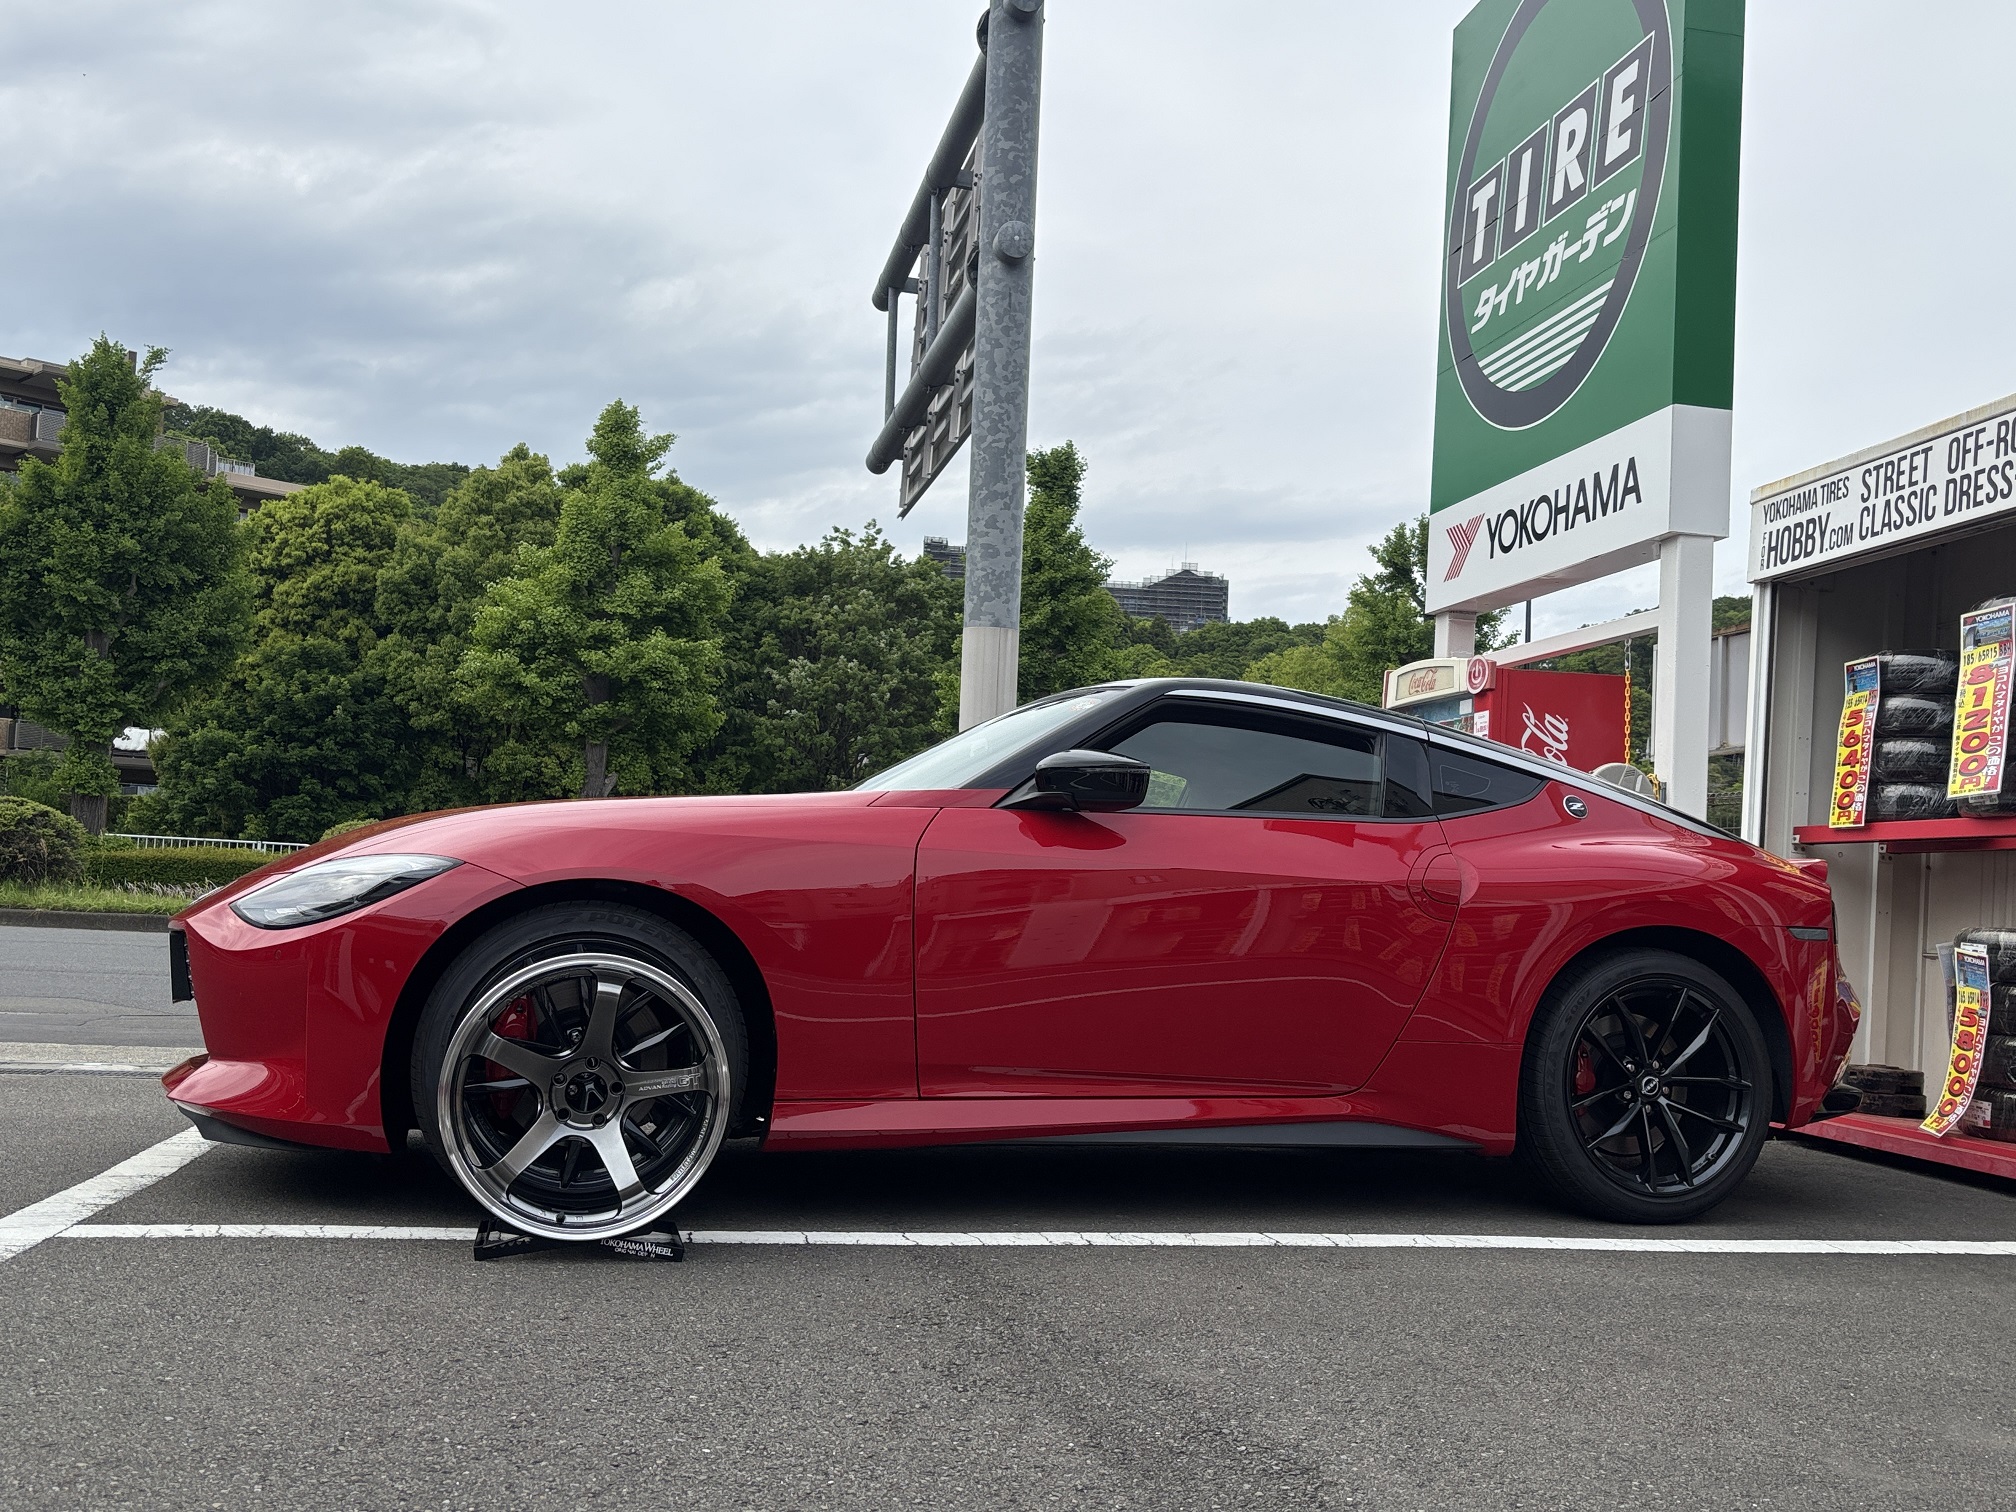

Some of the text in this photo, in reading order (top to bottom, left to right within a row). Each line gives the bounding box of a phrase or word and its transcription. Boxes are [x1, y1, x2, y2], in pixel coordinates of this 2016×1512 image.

[1471, 59, 1640, 267] TIRE
[1470, 188, 1637, 335] タイヤガーデン
[1486, 456, 1642, 560] YOKOHAMA
[1763, 476, 1850, 526] YOKOHAMA TIRES
[1859, 460, 2016, 542] CLASSIC DRESS
[1860, 446, 1933, 504] STREET
[1975, 610, 2010, 622] YOKOHAMA
